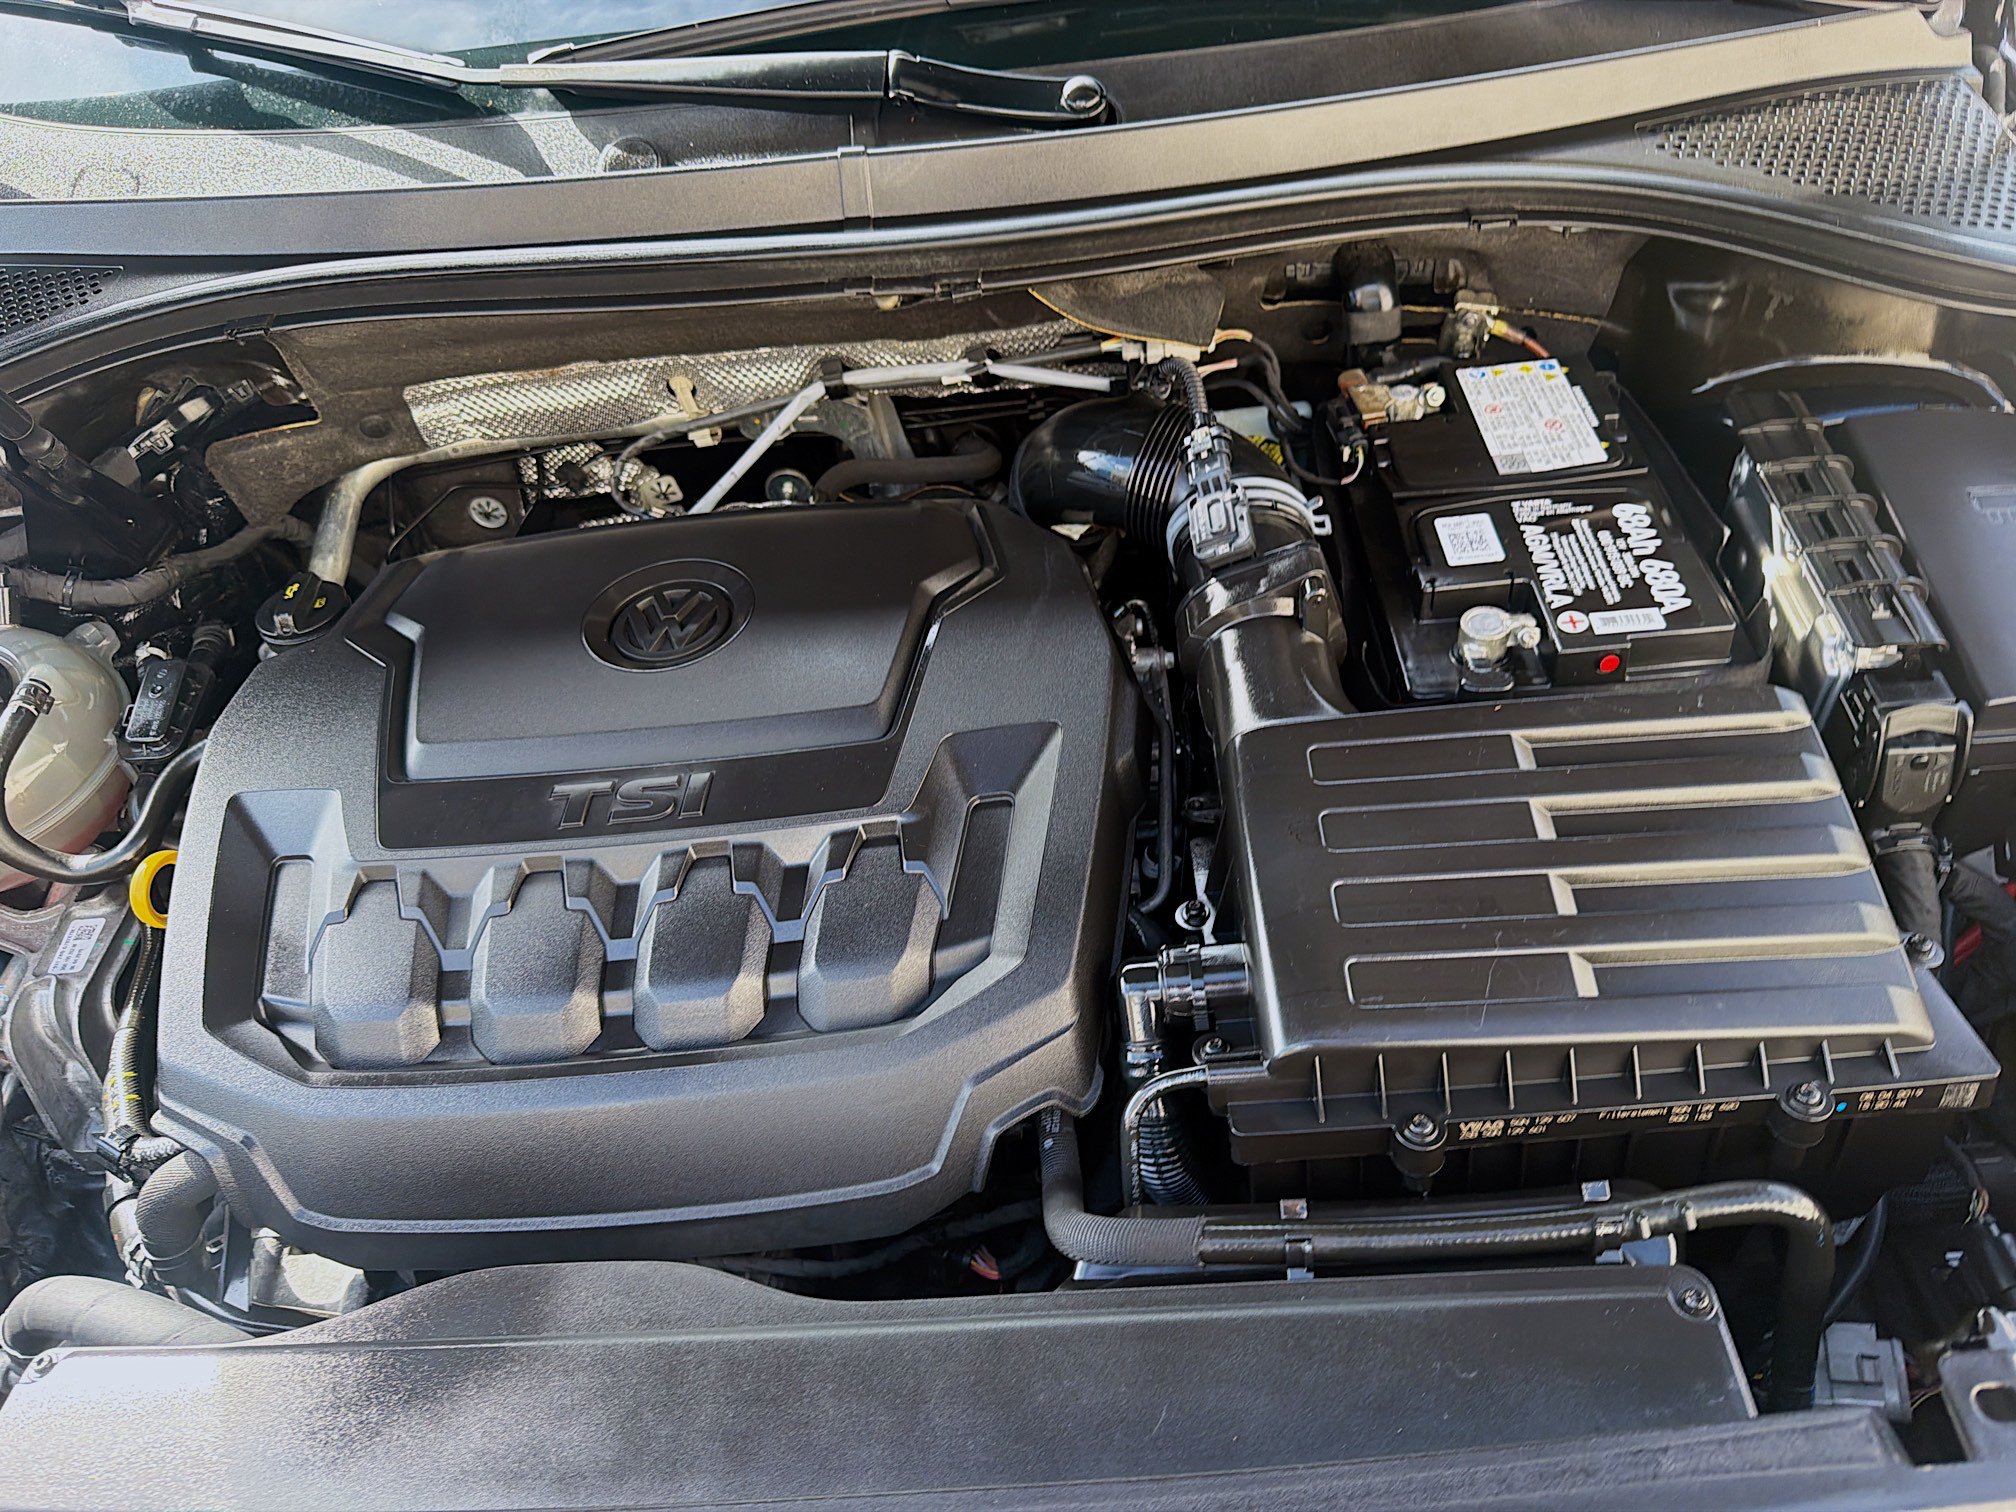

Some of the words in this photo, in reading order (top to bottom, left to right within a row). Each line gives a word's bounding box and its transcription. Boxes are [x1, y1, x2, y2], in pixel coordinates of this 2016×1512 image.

[1612, 503, 1662, 556] 68Ah
[1639, 558, 1692, 615] 680A
[616, 583, 728, 658] VW
[549, 771, 715, 829] TSI
